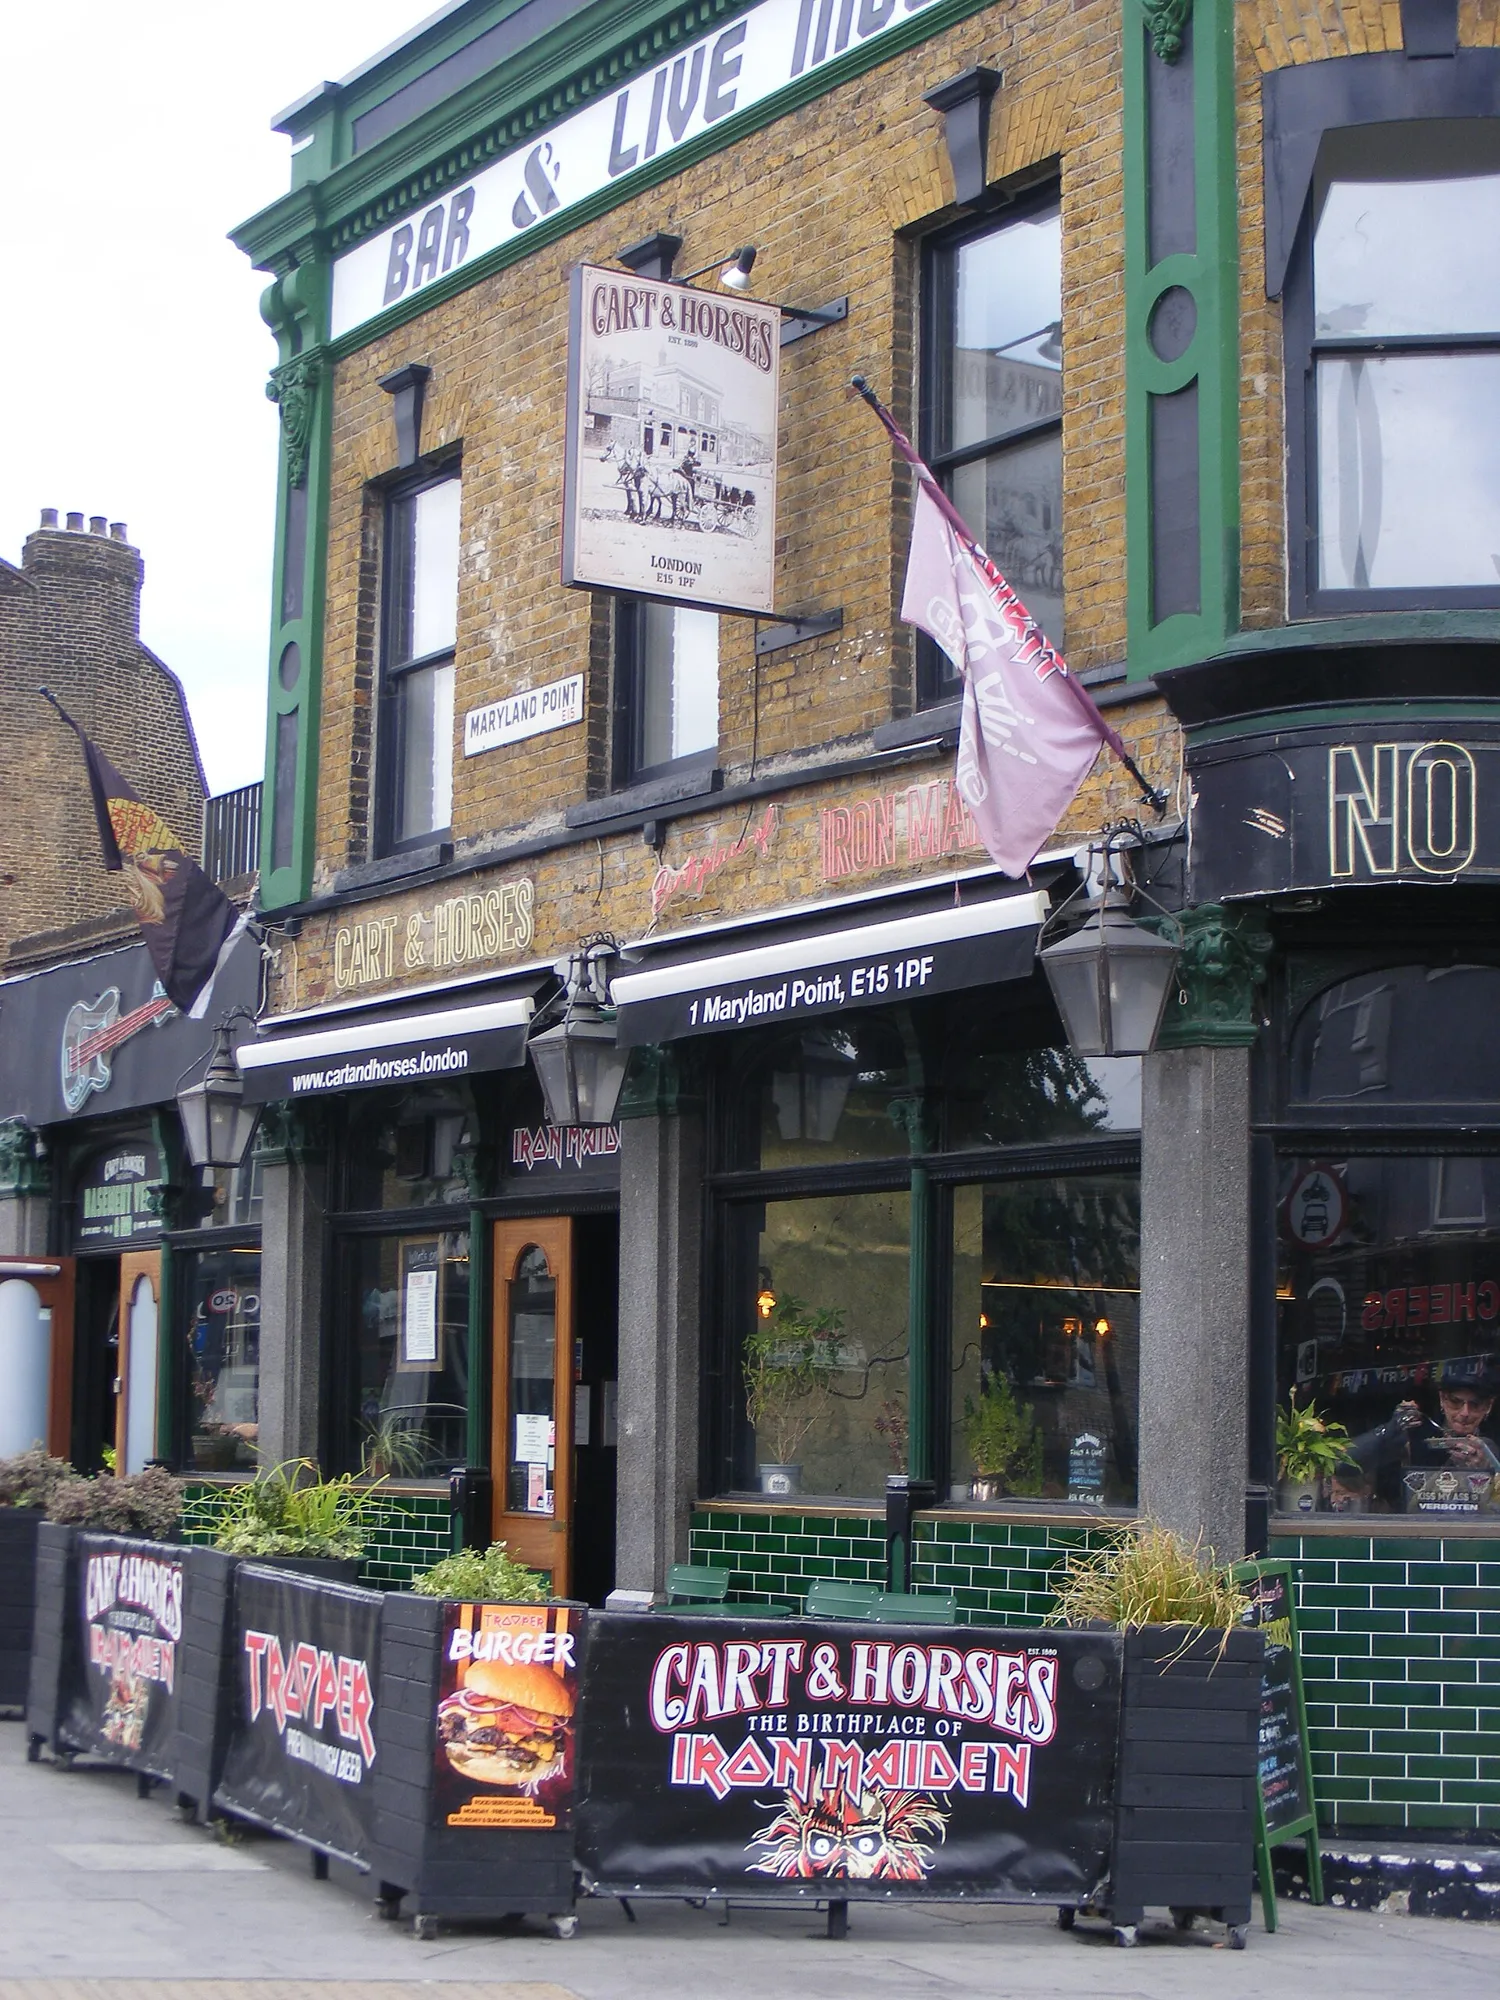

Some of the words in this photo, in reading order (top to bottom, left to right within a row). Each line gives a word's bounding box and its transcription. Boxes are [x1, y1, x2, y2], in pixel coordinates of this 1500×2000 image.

[382, 185, 475, 307] BAR
[511, 142, 562, 229] &
[607, 19, 748, 178] LIVE
[591, 283, 659, 338] CART
[661, 296, 677, 330] &
[678, 297, 773, 374] HORSES
[651, 555, 702, 576] LONDON
[656, 572, 674, 585] E15
[678, 576, 696, 588] 1PF
[470, 695, 537, 738] MARYLAND
[542, 682, 578, 714] POINT
[561, 707, 576, 722] E15
[1328, 741, 1477, 877] NO
[822, 794, 896, 880] IRON
[334, 915, 397, 989] CART
[404, 913, 427, 968] &
[433, 878, 535, 968] HORSES
[690, 1001, 699, 1025] 1
[703, 989, 787, 1024] Maryland
[789, 973, 845, 1009] Point,
[850, 966, 890, 996] E15
[894, 955, 934, 990] 1PF
[292, 1046, 468, 1092] www.cartandhorses.london
[513, 1124, 563, 1172] IRON
[1419, 1502, 1479, 1511] VERBOTEN
[1437, 1492, 1451, 1500] MY
[1452, 1493, 1470, 1501] ASS
[484, 1614, 545, 1629] TROOPER
[449, 1628, 577, 1668] BURGER
[1027, 1647, 1041, 1656] EST.
[651, 1641, 804, 1732] CART
[805, 1640, 846, 1701] &
[850, 1644, 1058, 1746] HORSES
[748, 1715, 792, 1734] THE
[797, 1714, 925, 1735] BIRTHPLACE
[934, 1720, 963, 1737] OF
[671, 1732, 814, 1804] IRON
[820, 1737, 1033, 1809] MAIDEN
